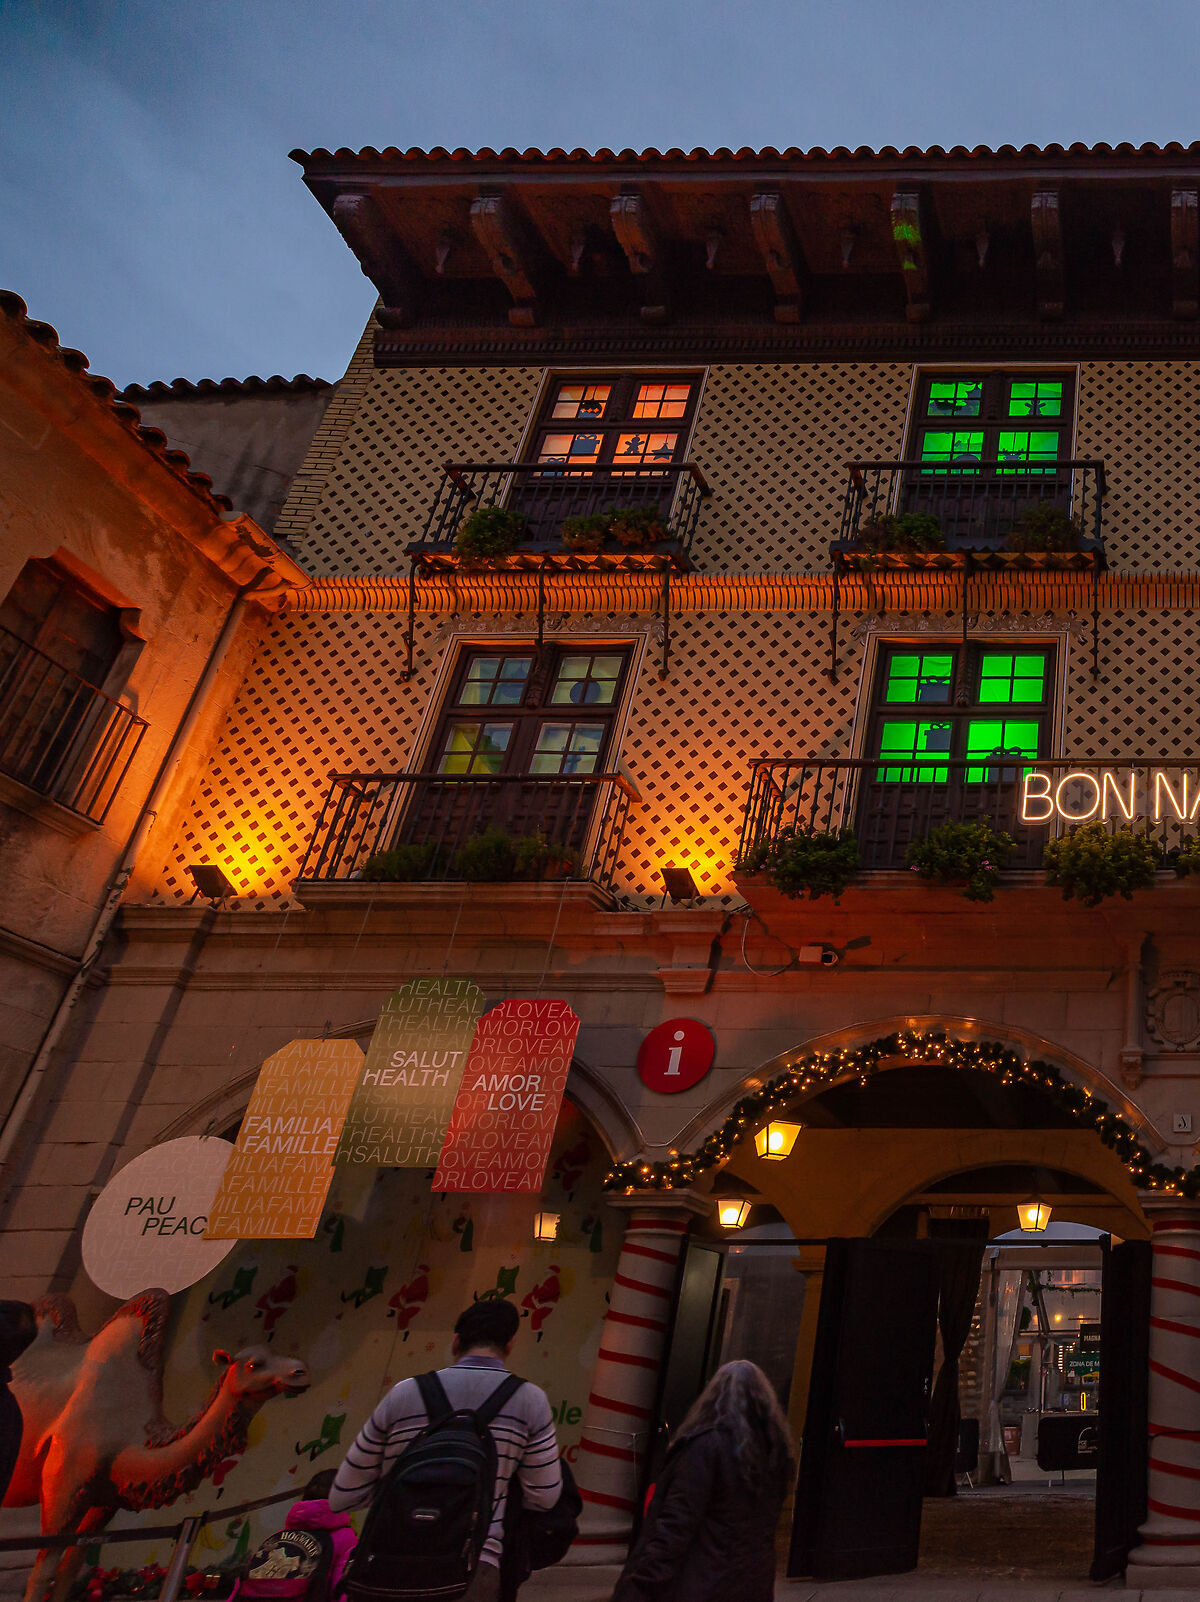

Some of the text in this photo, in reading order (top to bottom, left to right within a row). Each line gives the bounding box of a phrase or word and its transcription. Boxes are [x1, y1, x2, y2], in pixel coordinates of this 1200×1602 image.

[1021, 771, 1136, 821] BON
[390, 1050, 463, 1068] SALUT
[362, 1068, 450, 1088] HEALTH
[472, 1074, 541, 1092] AMOR
[487, 1093, 545, 1111] LOVE
[243, 1115, 333, 1134] FAMILIA
[242, 1135, 340, 1154] FAMILLE
[124, 1196, 177, 1216] PAU
[141, 1216, 209, 1236] PEAC
